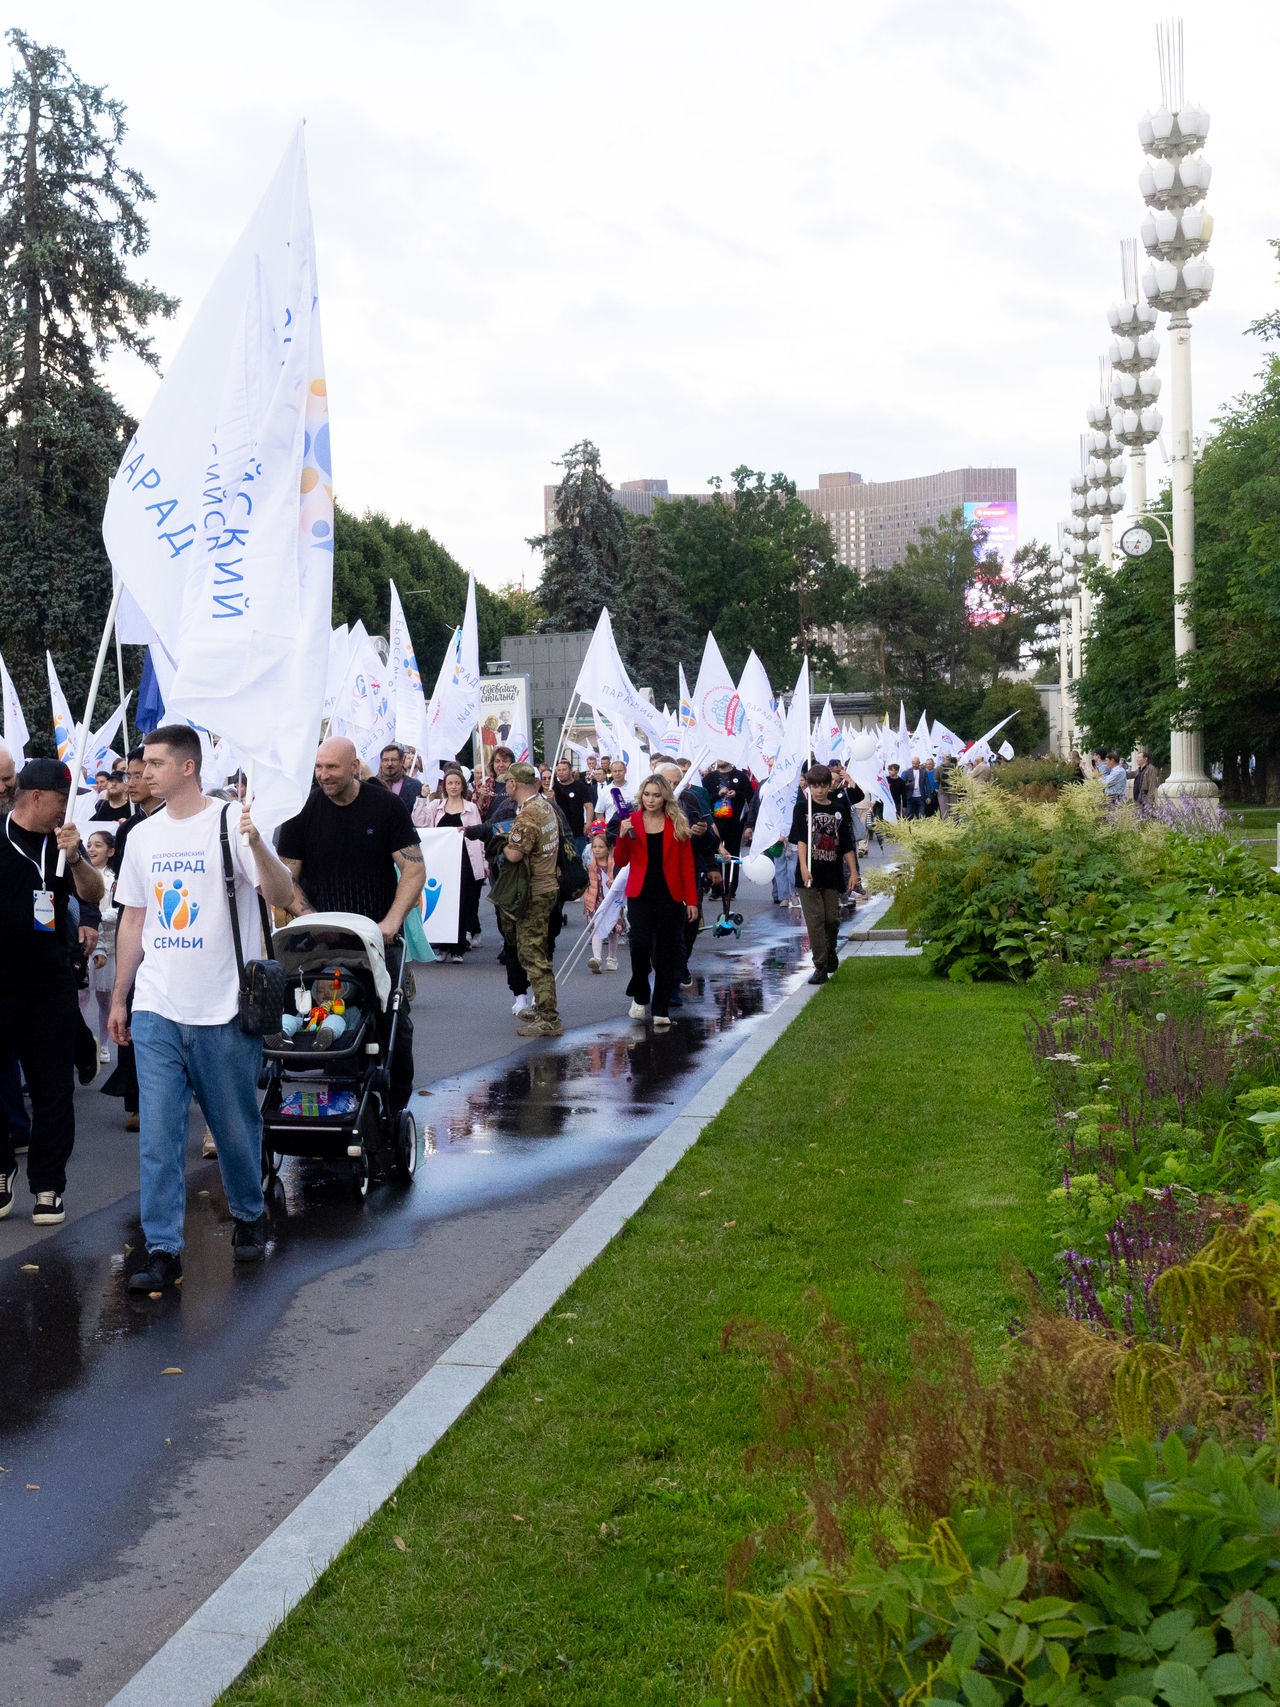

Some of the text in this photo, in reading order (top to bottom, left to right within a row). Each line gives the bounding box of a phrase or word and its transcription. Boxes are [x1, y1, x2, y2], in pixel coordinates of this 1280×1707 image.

[152, 850, 205, 859] ВСЕРОССИЙСКИЙ
[151, 860, 205, 873] ПАРАД
[153, 936, 203, 949] СЕМЬИ
